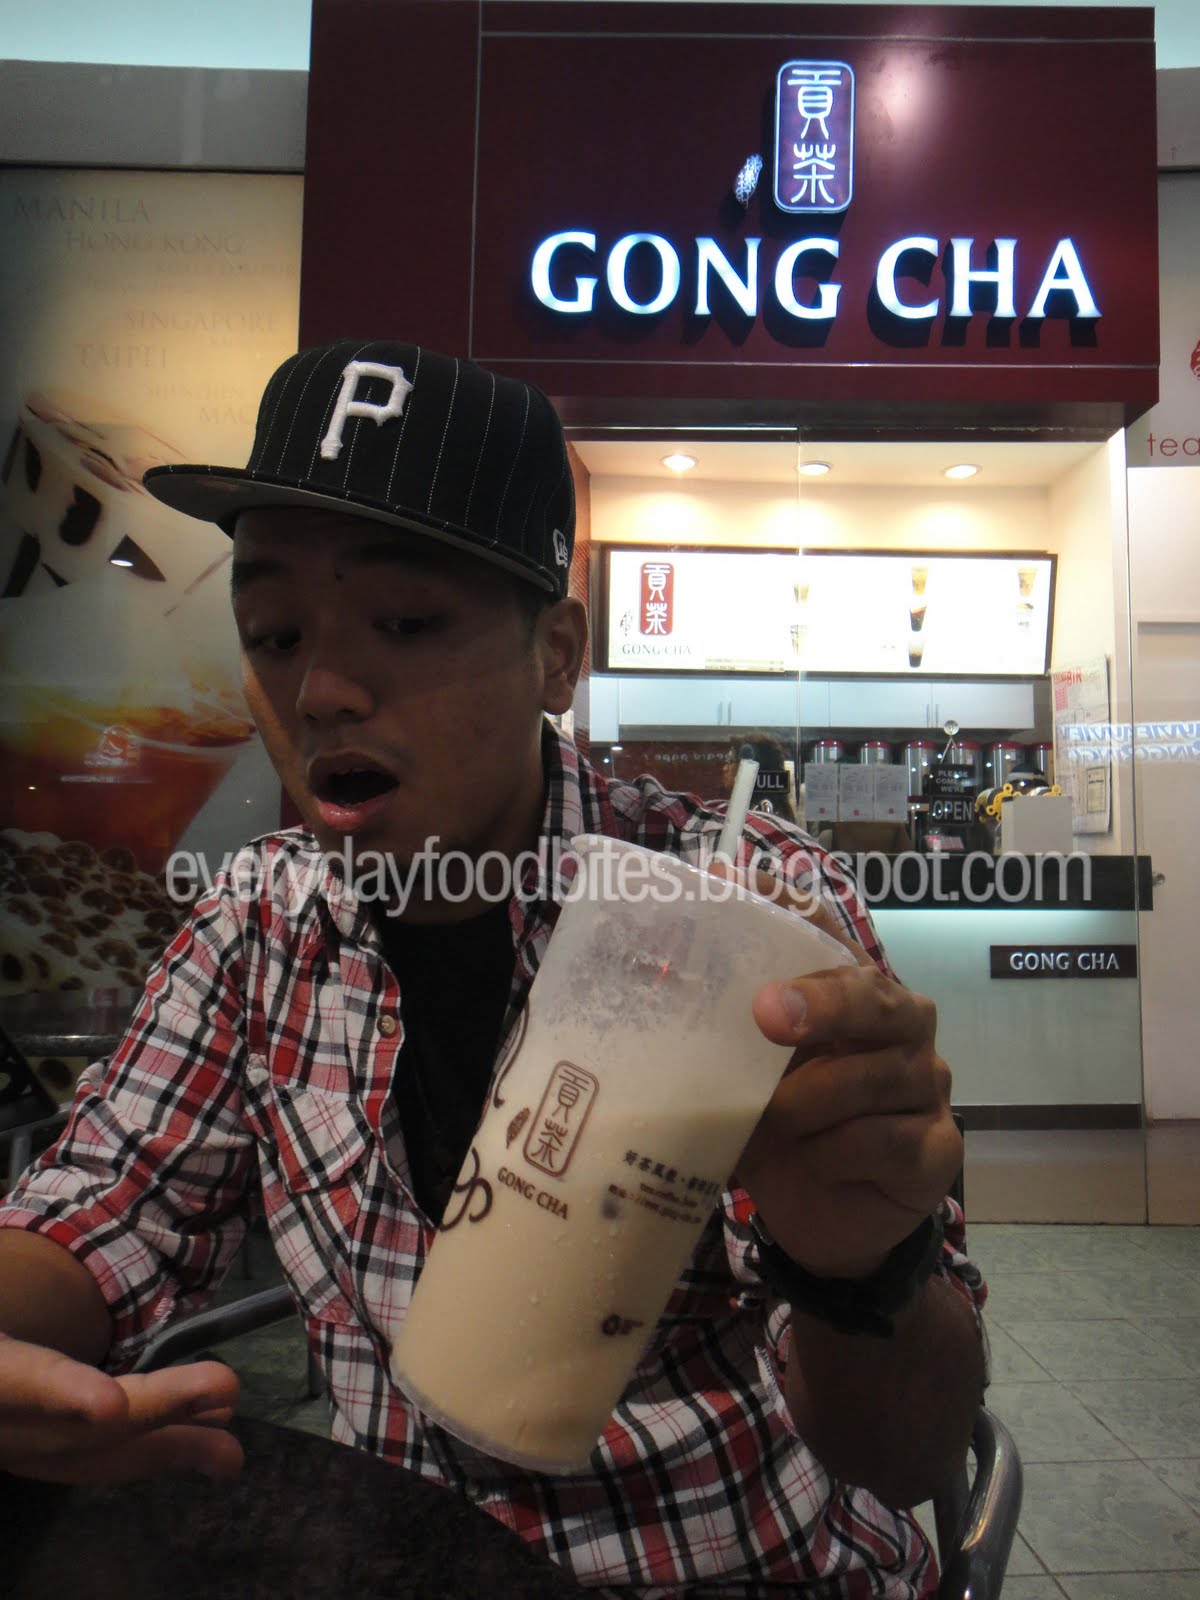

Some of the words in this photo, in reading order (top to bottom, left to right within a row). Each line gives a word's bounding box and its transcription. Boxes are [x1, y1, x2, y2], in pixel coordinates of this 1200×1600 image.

[786, 68, 843, 205] 貢茶
[14, 195, 152, 223] MANILA
[530, 229, 842, 320] GONG
[875, 236, 1102, 321] CHA
[320, 360, 414, 460] P
[622, 643, 660, 656] GONG
[664, 645, 691, 656] CHA
[757, 774, 785, 788] ULL
[938, 770, 968, 778] PLEASE
[933, 800, 972, 821] OPEN
[1008, 951, 1070, 972] GONG
[1077, 952, 1120, 972] CHA
[497, 1166, 537, 1201] GONG
[536, 1190, 570, 1220] CHA
